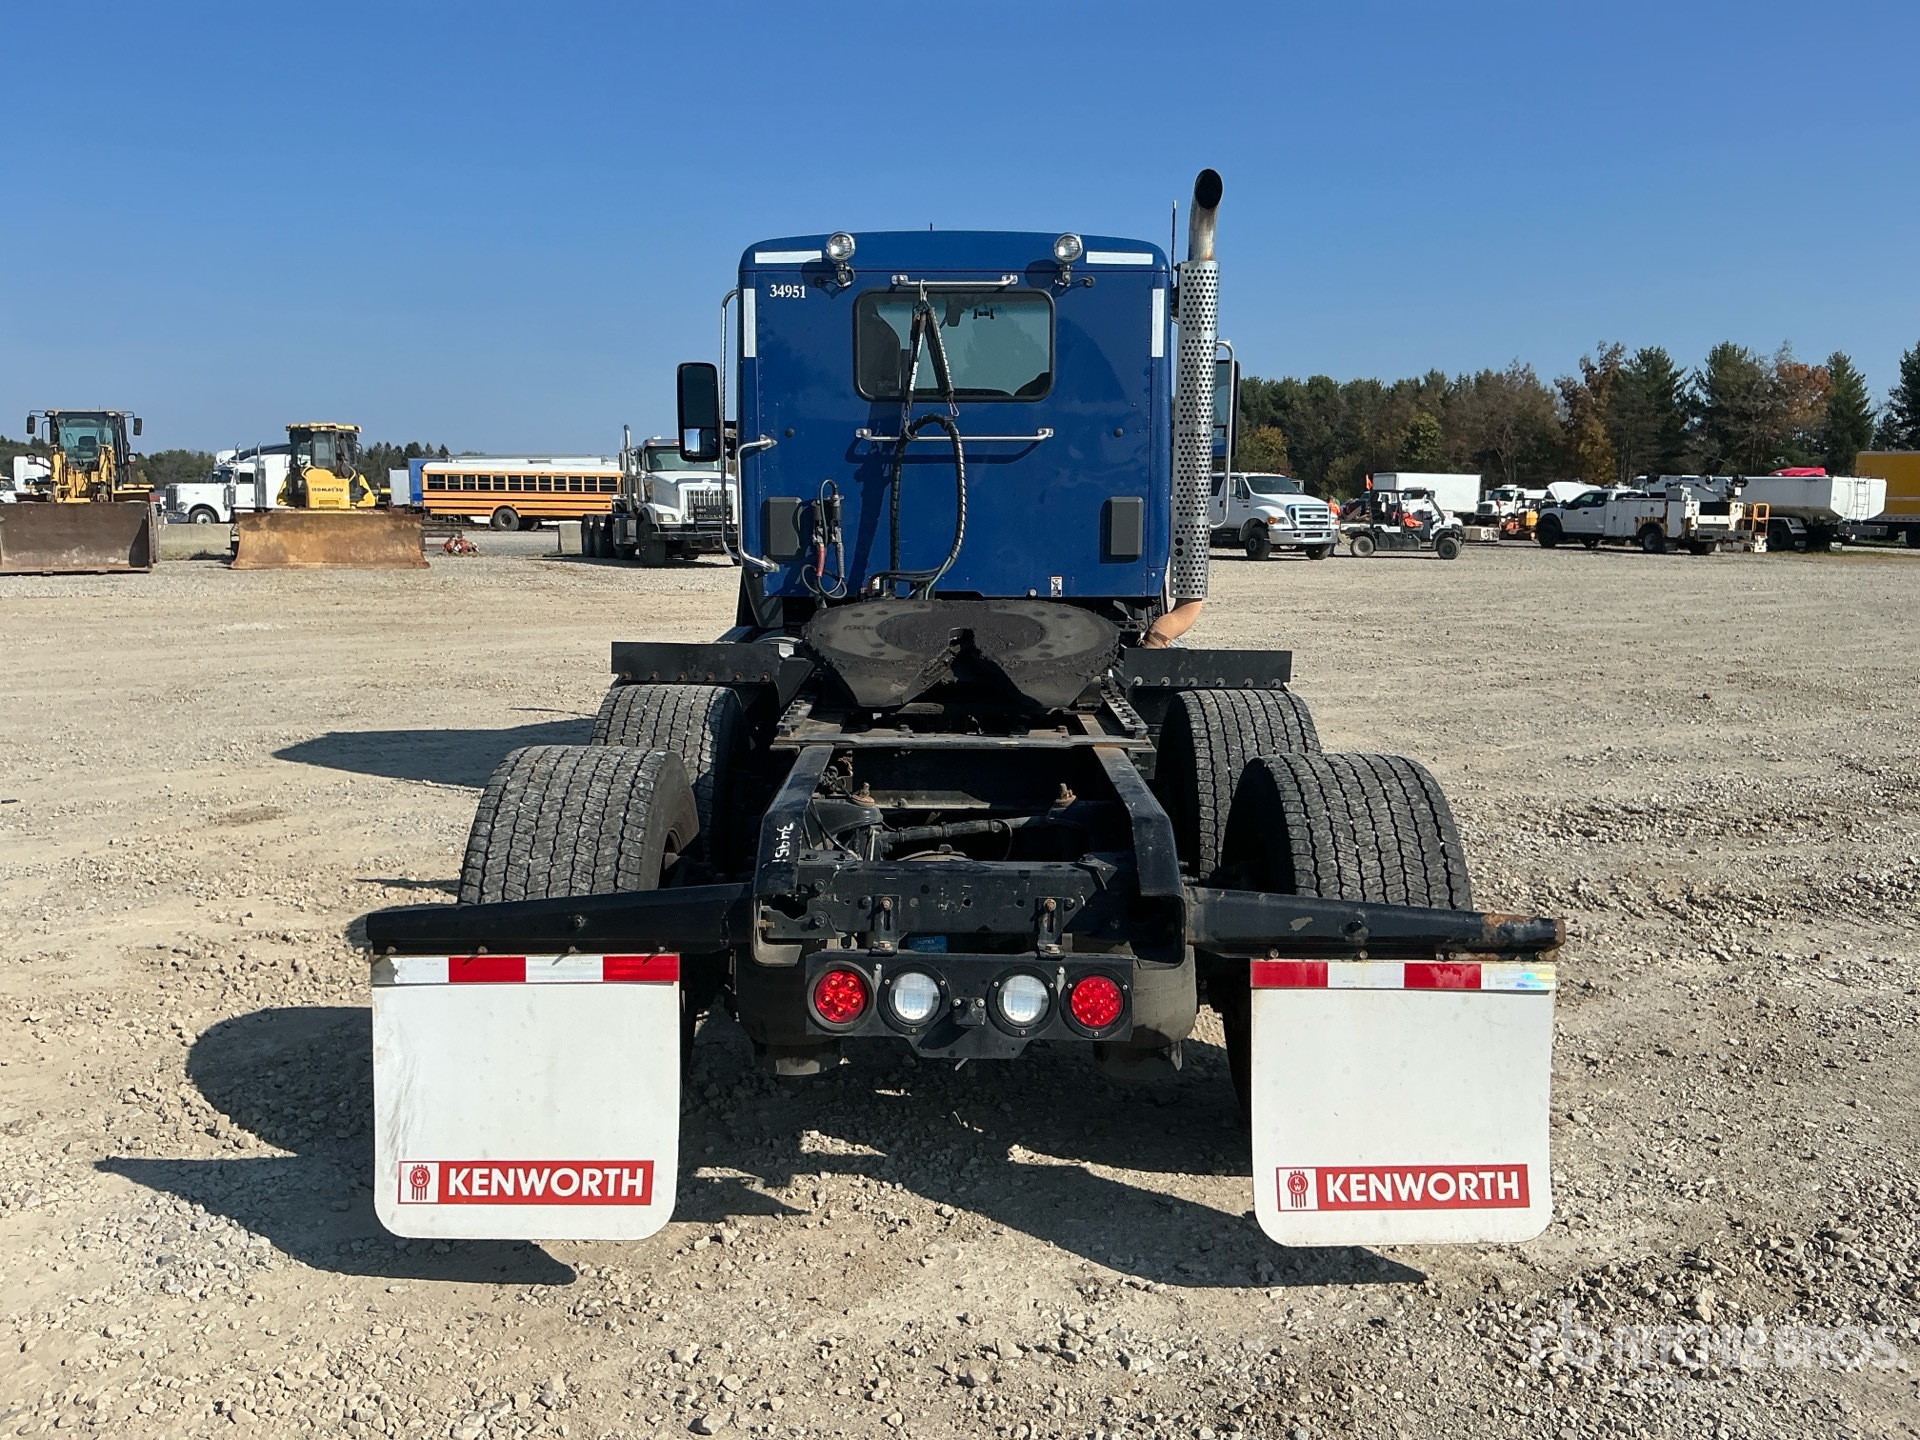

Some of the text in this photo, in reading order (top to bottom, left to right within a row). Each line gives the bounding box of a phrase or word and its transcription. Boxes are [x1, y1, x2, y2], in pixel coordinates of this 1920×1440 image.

[769, 284, 806, 299] 34951
[448, 1168, 645, 1197] KENWORTH
[1326, 1170, 1520, 1203] KENWORTH
